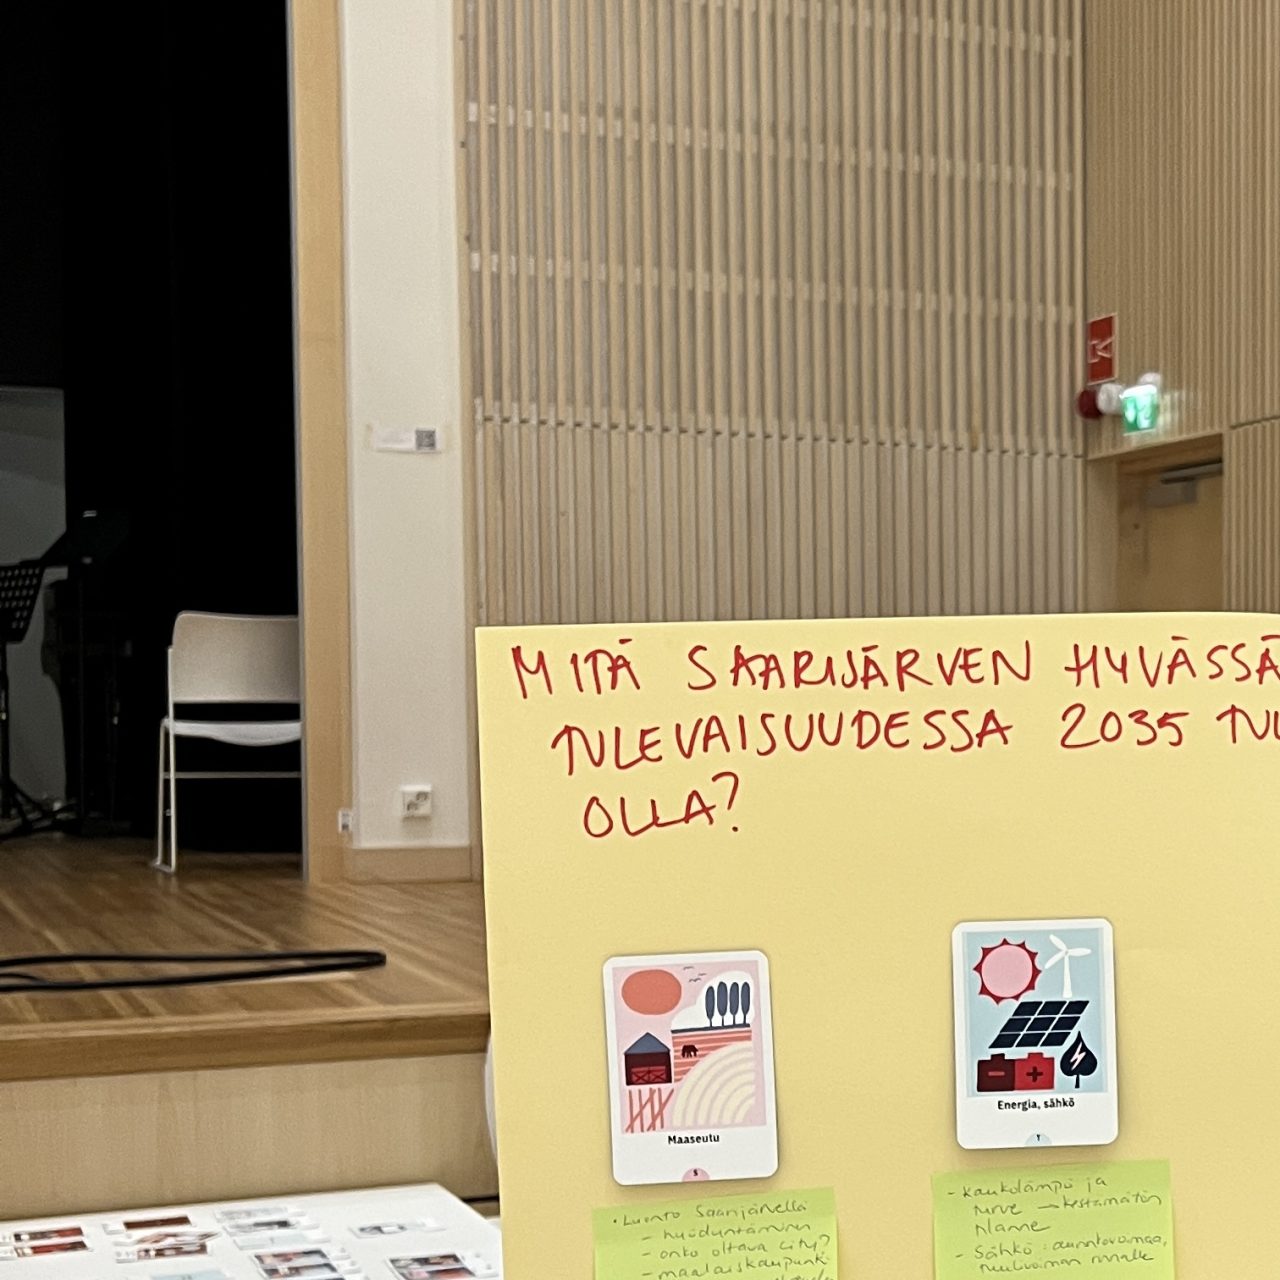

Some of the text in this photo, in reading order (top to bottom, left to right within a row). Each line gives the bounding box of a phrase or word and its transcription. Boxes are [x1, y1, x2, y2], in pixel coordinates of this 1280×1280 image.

[511, 639, 640, 699] MITÄ
[687, 640, 1031, 691] SAARIJÄRVEN
[551, 708, 1014, 776] TULEVAISUUDESSA
[1060, 703, 1190, 749] 2035
[583, 771, 740, 837] OLLA?
[997, 1097, 1075, 1112] Energia, sähkö
[667, 1133, 720, 1145] Maaseutu
[1087, 1177, 1106, 1193] ja
[623, 1210, 681, 1227] Luonto
[659, 1246, 699, 1260] onko
[711, 1241, 768, 1258] oltava
